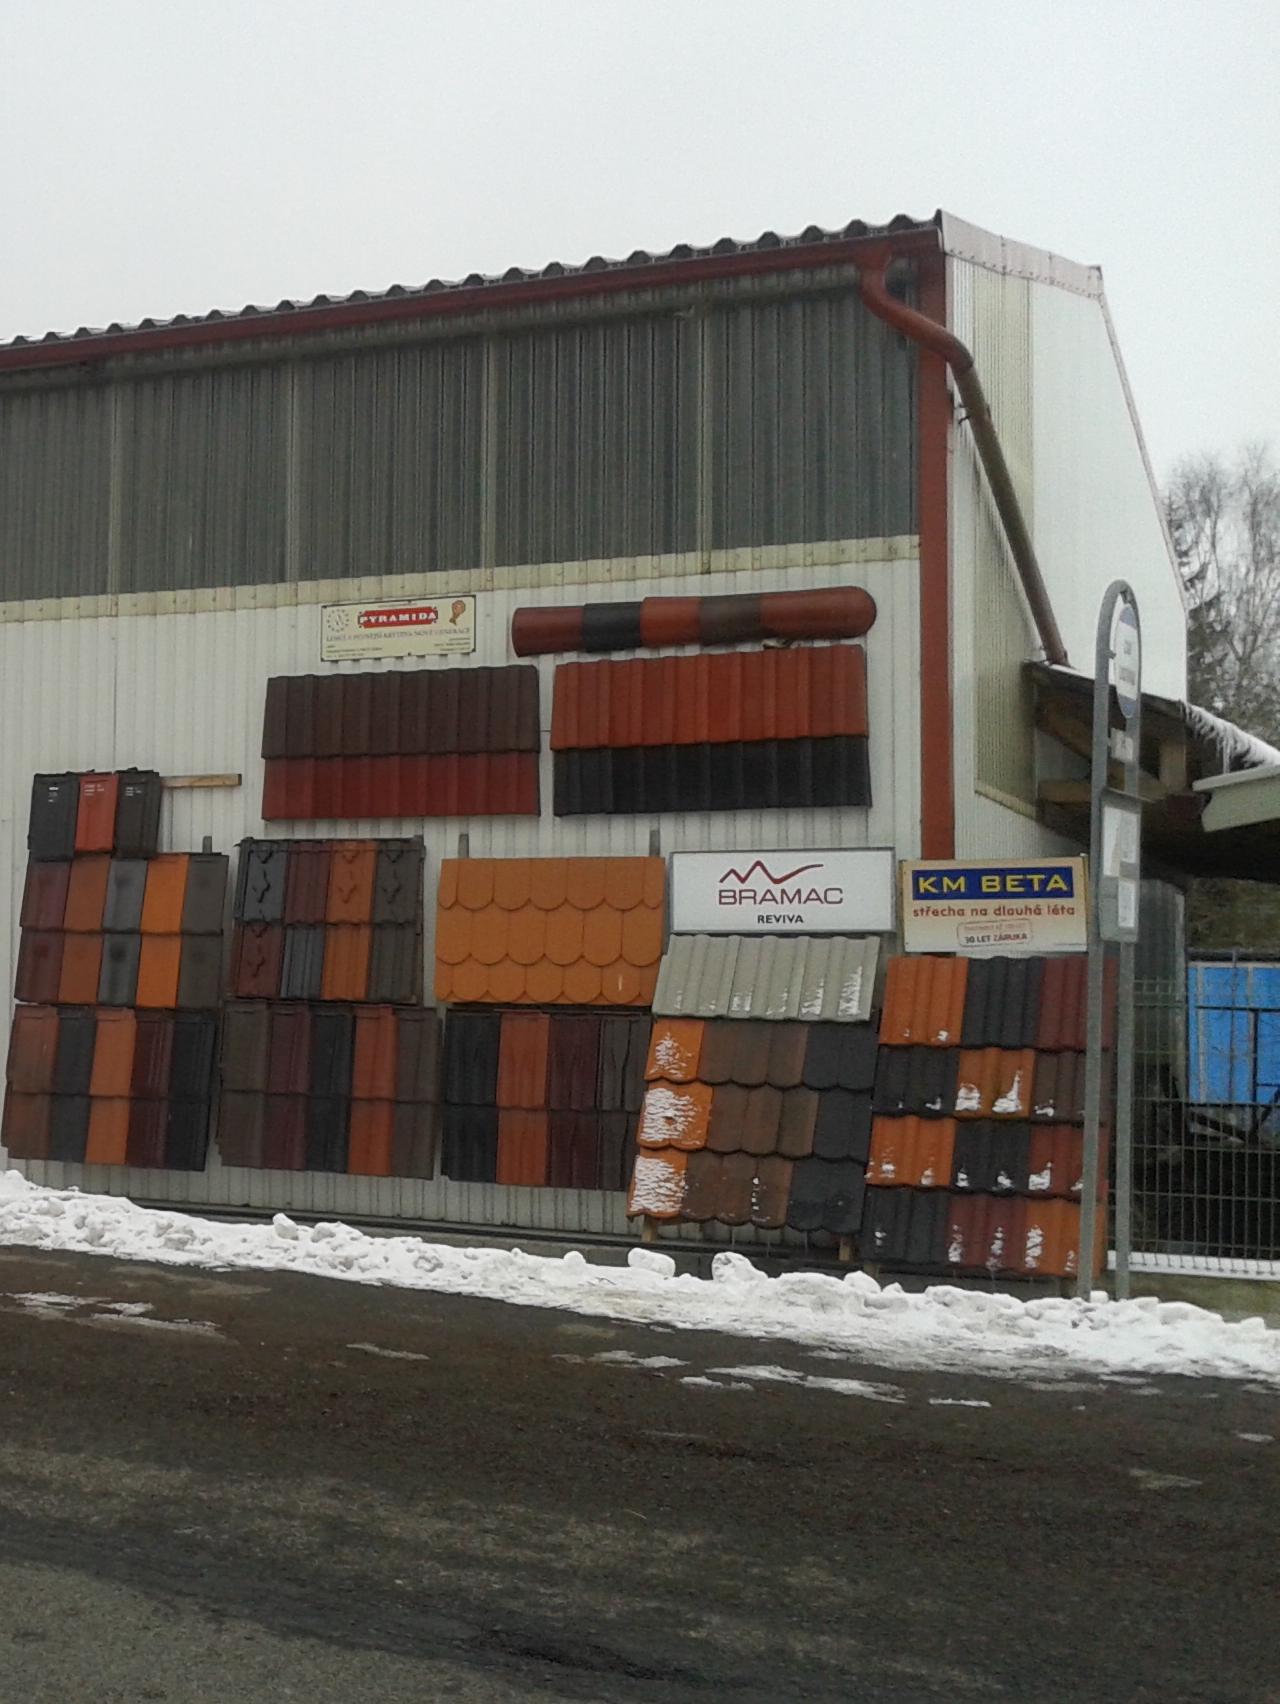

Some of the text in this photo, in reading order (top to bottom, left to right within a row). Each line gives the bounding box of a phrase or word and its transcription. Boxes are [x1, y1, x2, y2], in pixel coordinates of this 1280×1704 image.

[360, 612, 437, 624] PYRAMIDA
[919, 874, 1068, 893] KM BETA
[718, 887, 843, 906] BRAMAC
[913, 904, 1076, 917] střecha na dlouhá léta
[757, 914, 804, 925] REVIVA
[976, 935, 991, 943] LET
